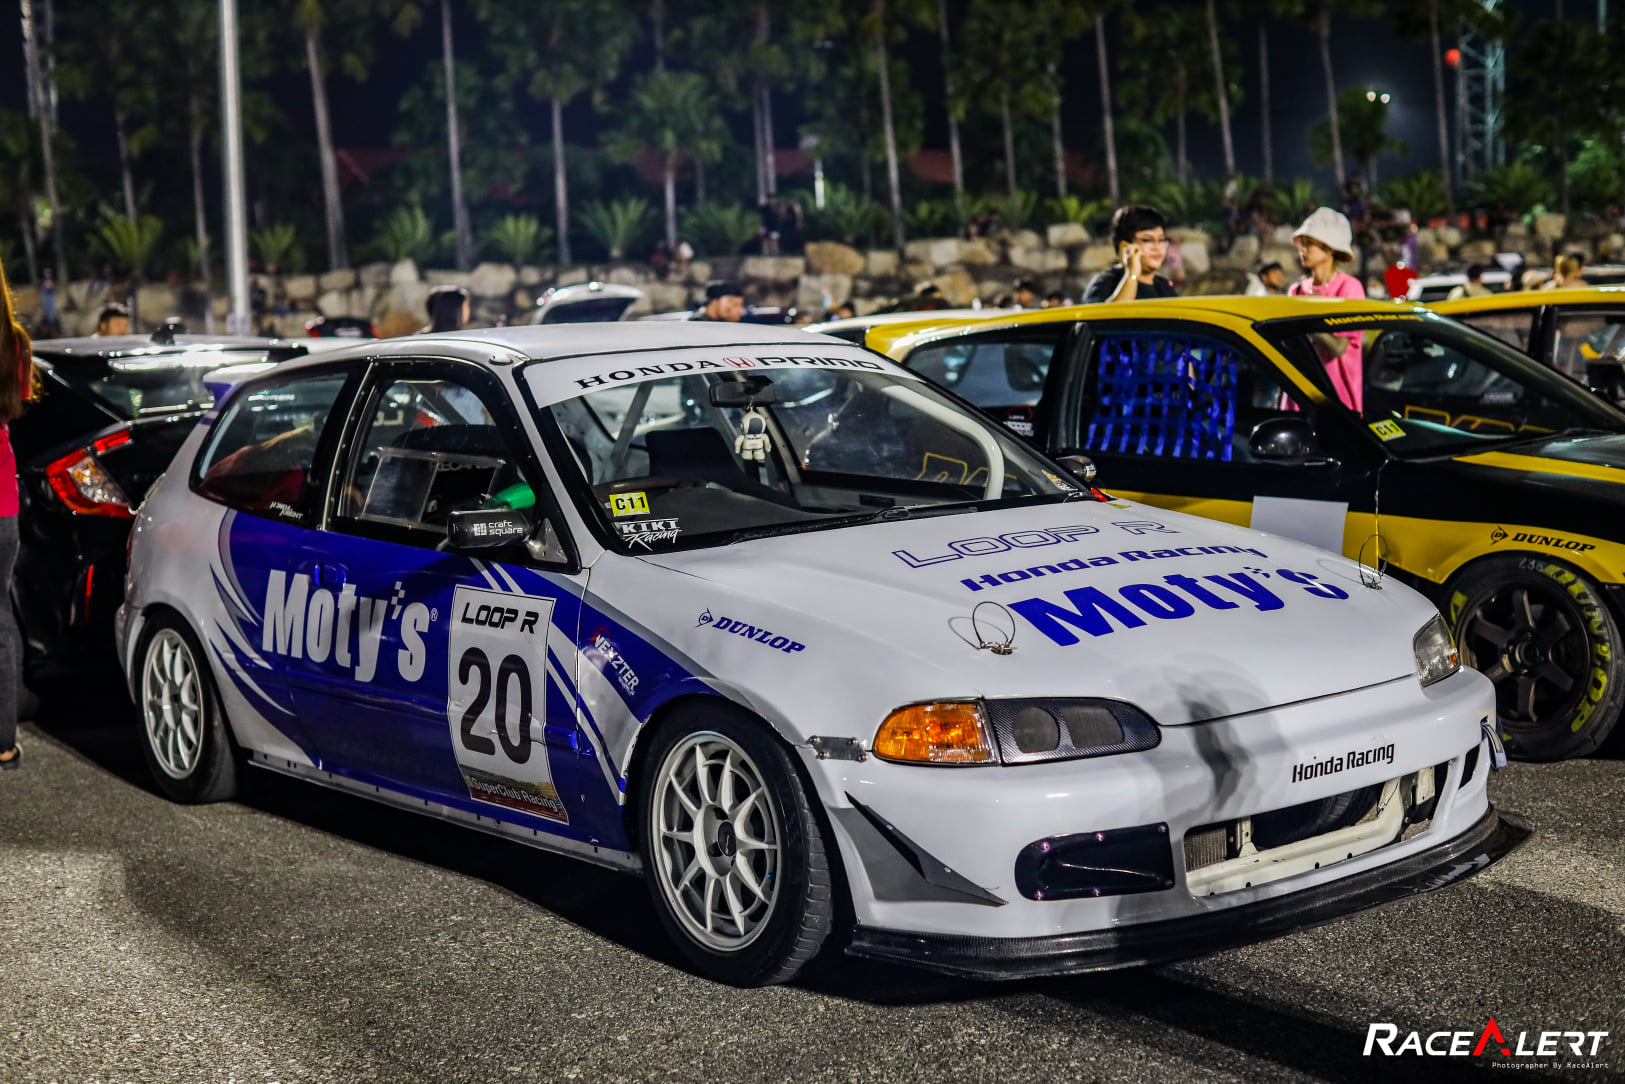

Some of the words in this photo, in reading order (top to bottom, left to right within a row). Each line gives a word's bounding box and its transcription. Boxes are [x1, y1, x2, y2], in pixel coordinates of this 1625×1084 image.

[573, 359, 723, 390] HONDA
[756, 356, 885, 371] PRIMO
[615, 496, 646, 511] C11
[488, 520, 513, 529] craft
[489, 527, 523, 536] square
[622, 520, 678, 534] KIKI
[623, 528, 682, 551] Racing
[1512, 532, 1596, 552] DUNLOP
[891, 524, 1101, 569] LOOP
[1110, 519, 1181, 535] R
[960, 554, 1119, 592] Honda
[1119, 545, 1268, 563] Racing
[461, 602, 516, 630] LOOP
[520, 610, 539, 634] R
[1006, 565, 1349, 647] Moty's
[262, 568, 430, 683] Moty's
[712, 616, 806, 654] DUNLOP
[593, 632, 641, 691] NEXZTER
[458, 646, 533, 765] 20
[1291, 755, 1344, 784] Honda
[1346, 743, 1395, 770] Racing
[471, 778, 521, 801] SuperClub
[522, 790, 559, 813] Racing
